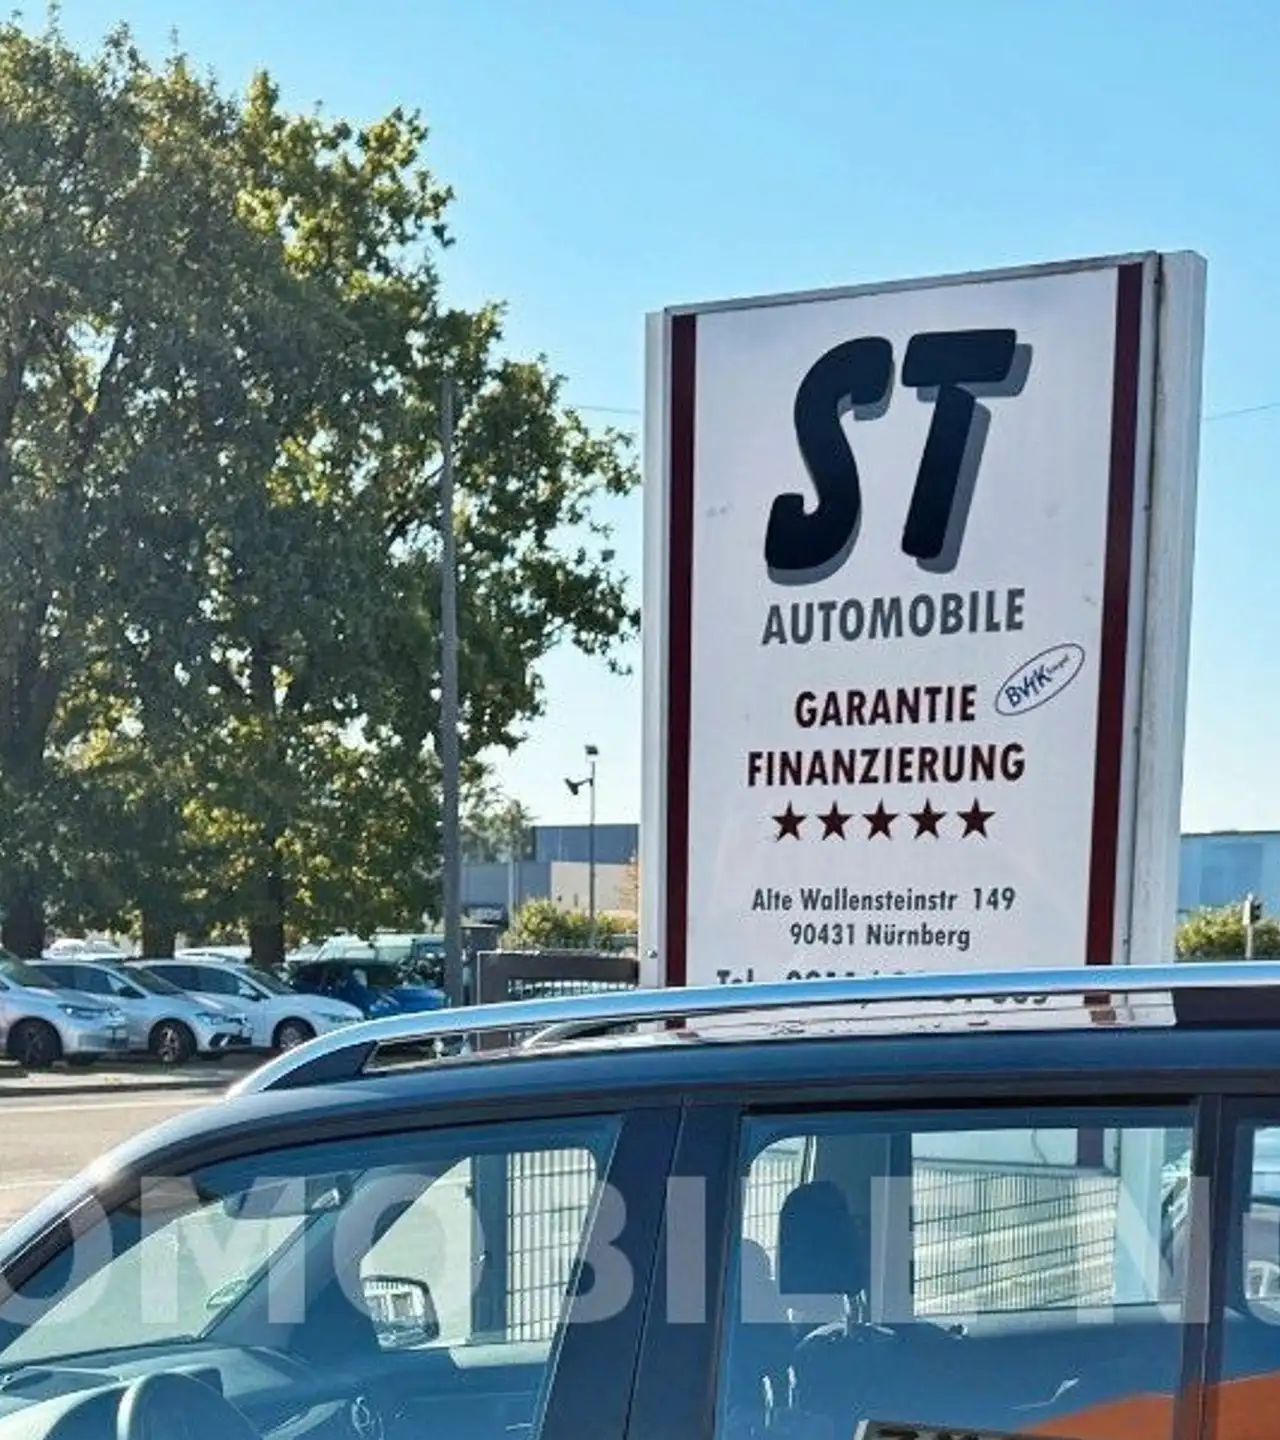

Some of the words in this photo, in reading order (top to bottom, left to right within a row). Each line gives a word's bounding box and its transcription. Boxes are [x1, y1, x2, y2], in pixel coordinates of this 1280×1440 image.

[764, 329, 1032, 585] ST
[762, 588, 1025, 645] AUTOMOBILE
[795, 684, 977, 728] GARANTIE
[748, 743, 1025, 787] FINANZIERUNG
[752, 889, 792, 911] Alte
[800, 888, 958, 911] Wallensteinstr
[973, 887, 1016, 911] 149
[790, 922, 856, 946] 90431
[866, 922, 971, 951] Nürnberg
